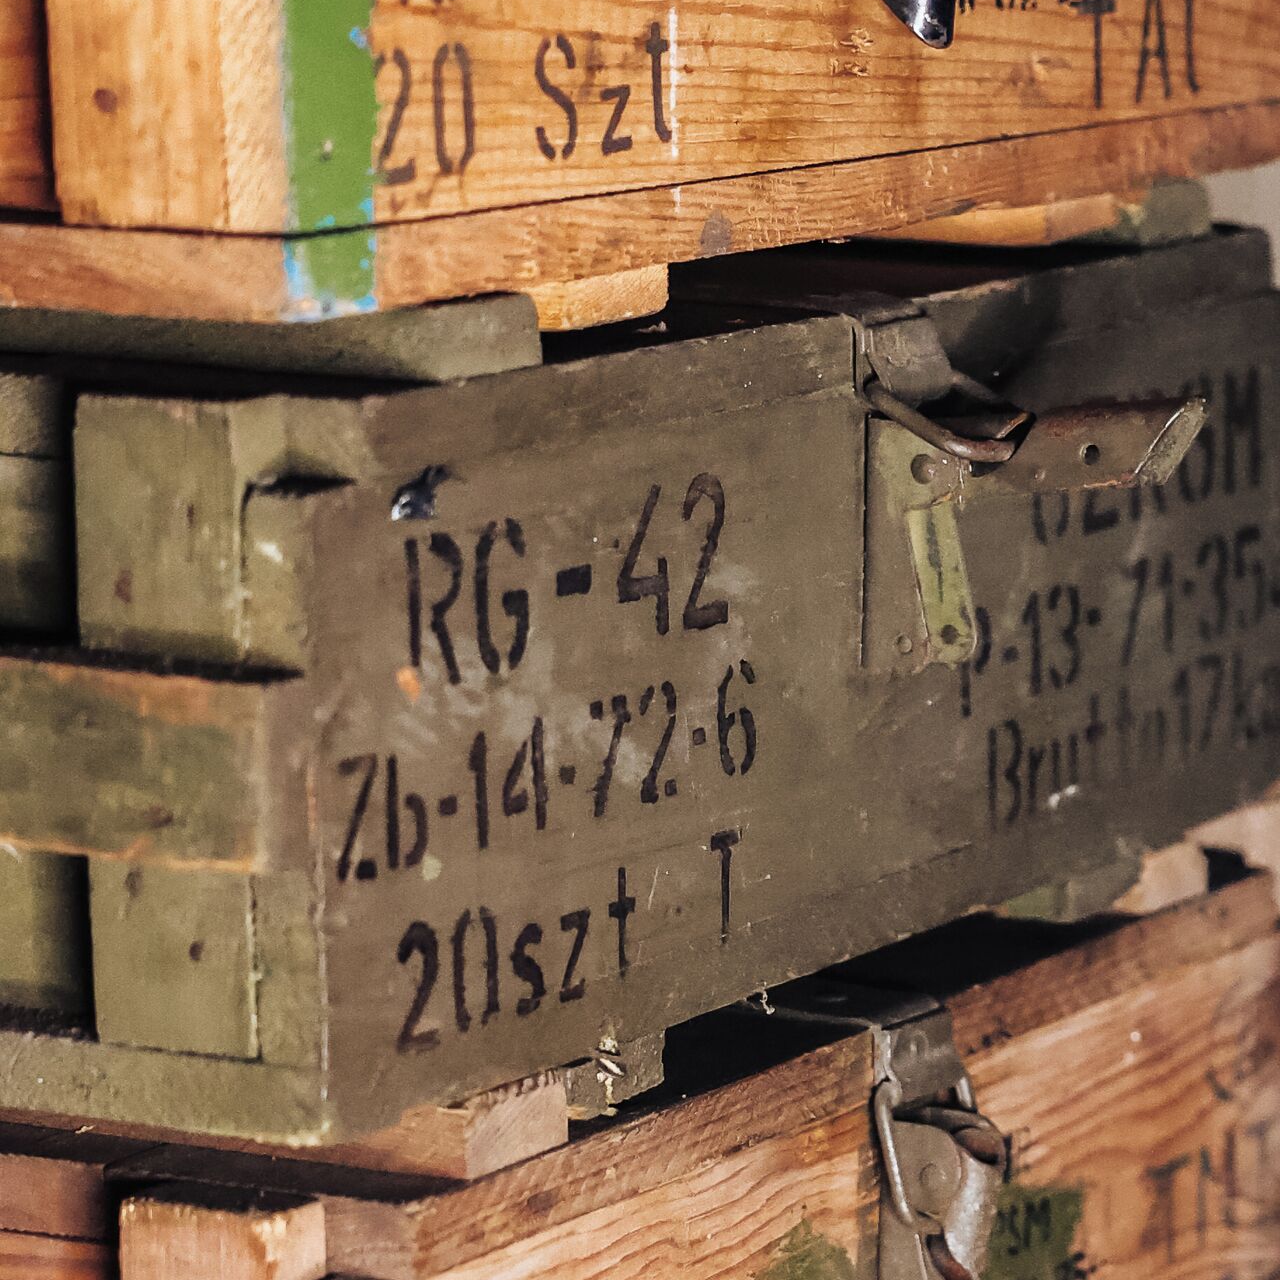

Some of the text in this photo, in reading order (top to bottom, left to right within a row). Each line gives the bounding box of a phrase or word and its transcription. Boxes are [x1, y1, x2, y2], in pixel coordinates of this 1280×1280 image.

[373, 20, 673, 185] 20 Szt
[405, 472, 729, 685] RG-42
